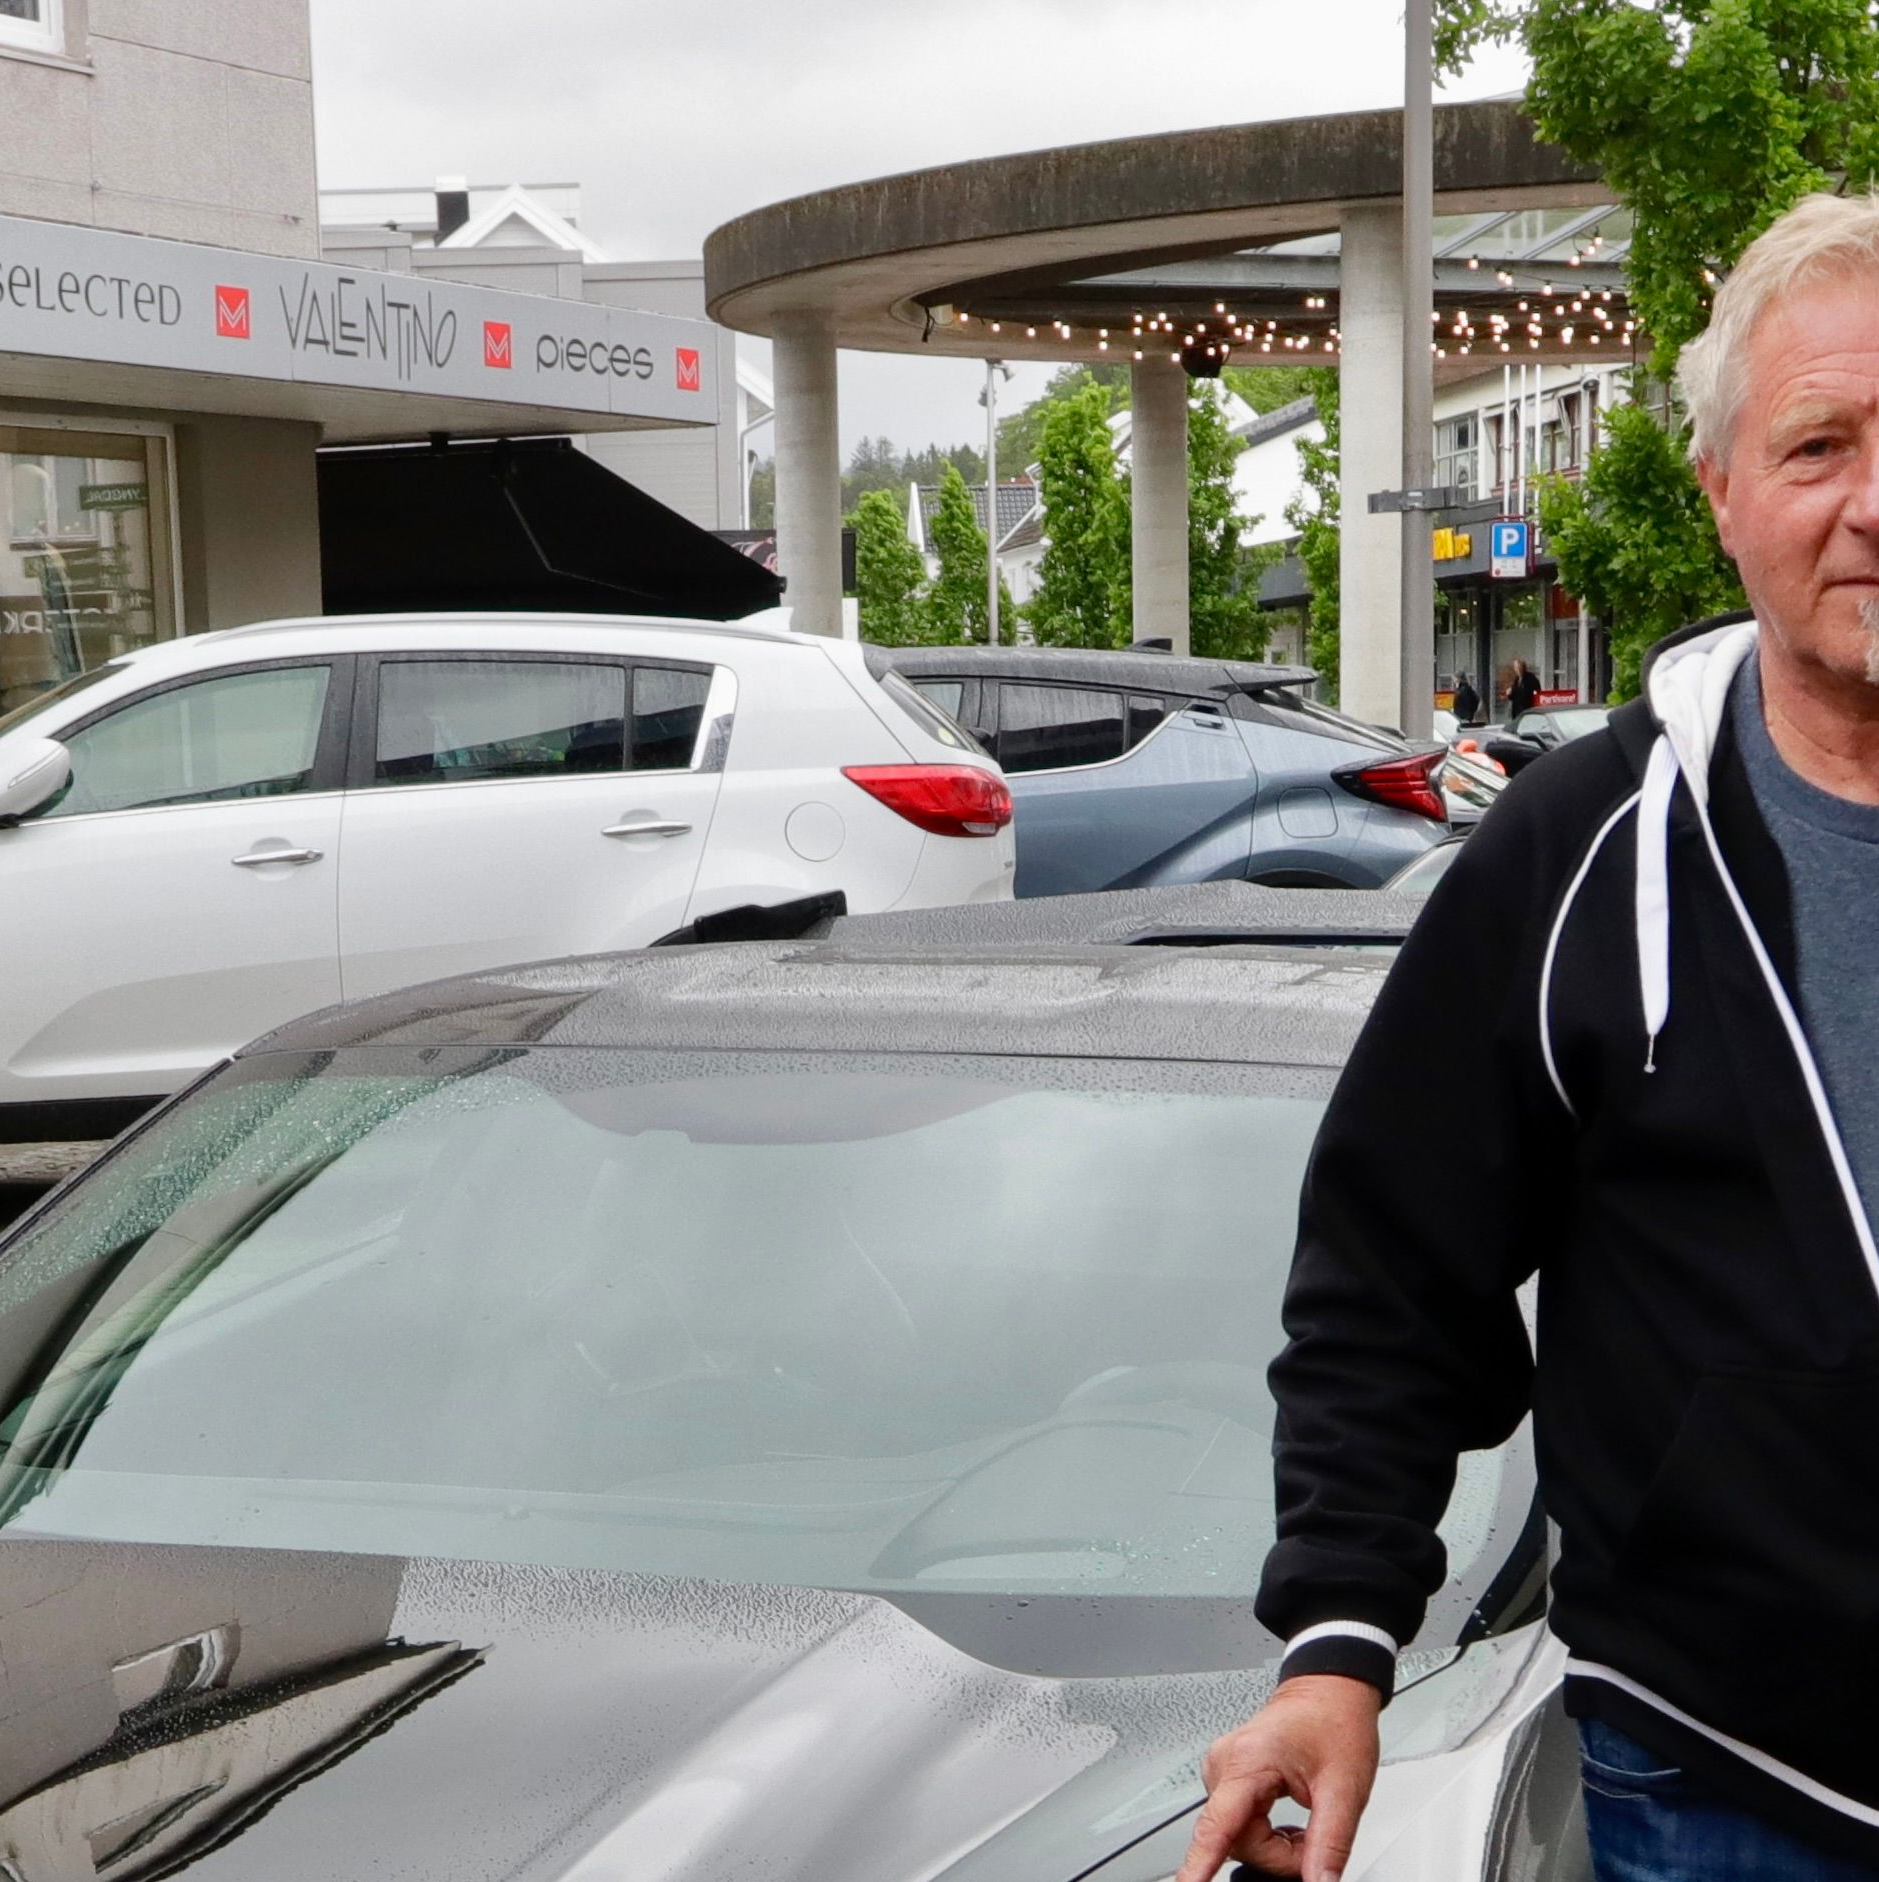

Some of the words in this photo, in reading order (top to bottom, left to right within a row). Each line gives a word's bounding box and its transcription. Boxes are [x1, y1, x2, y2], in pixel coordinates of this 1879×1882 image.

[279, 272, 459, 381] VALENTINO
[536, 333, 654, 381] pieces
[1501, 527, 1520, 555] P
